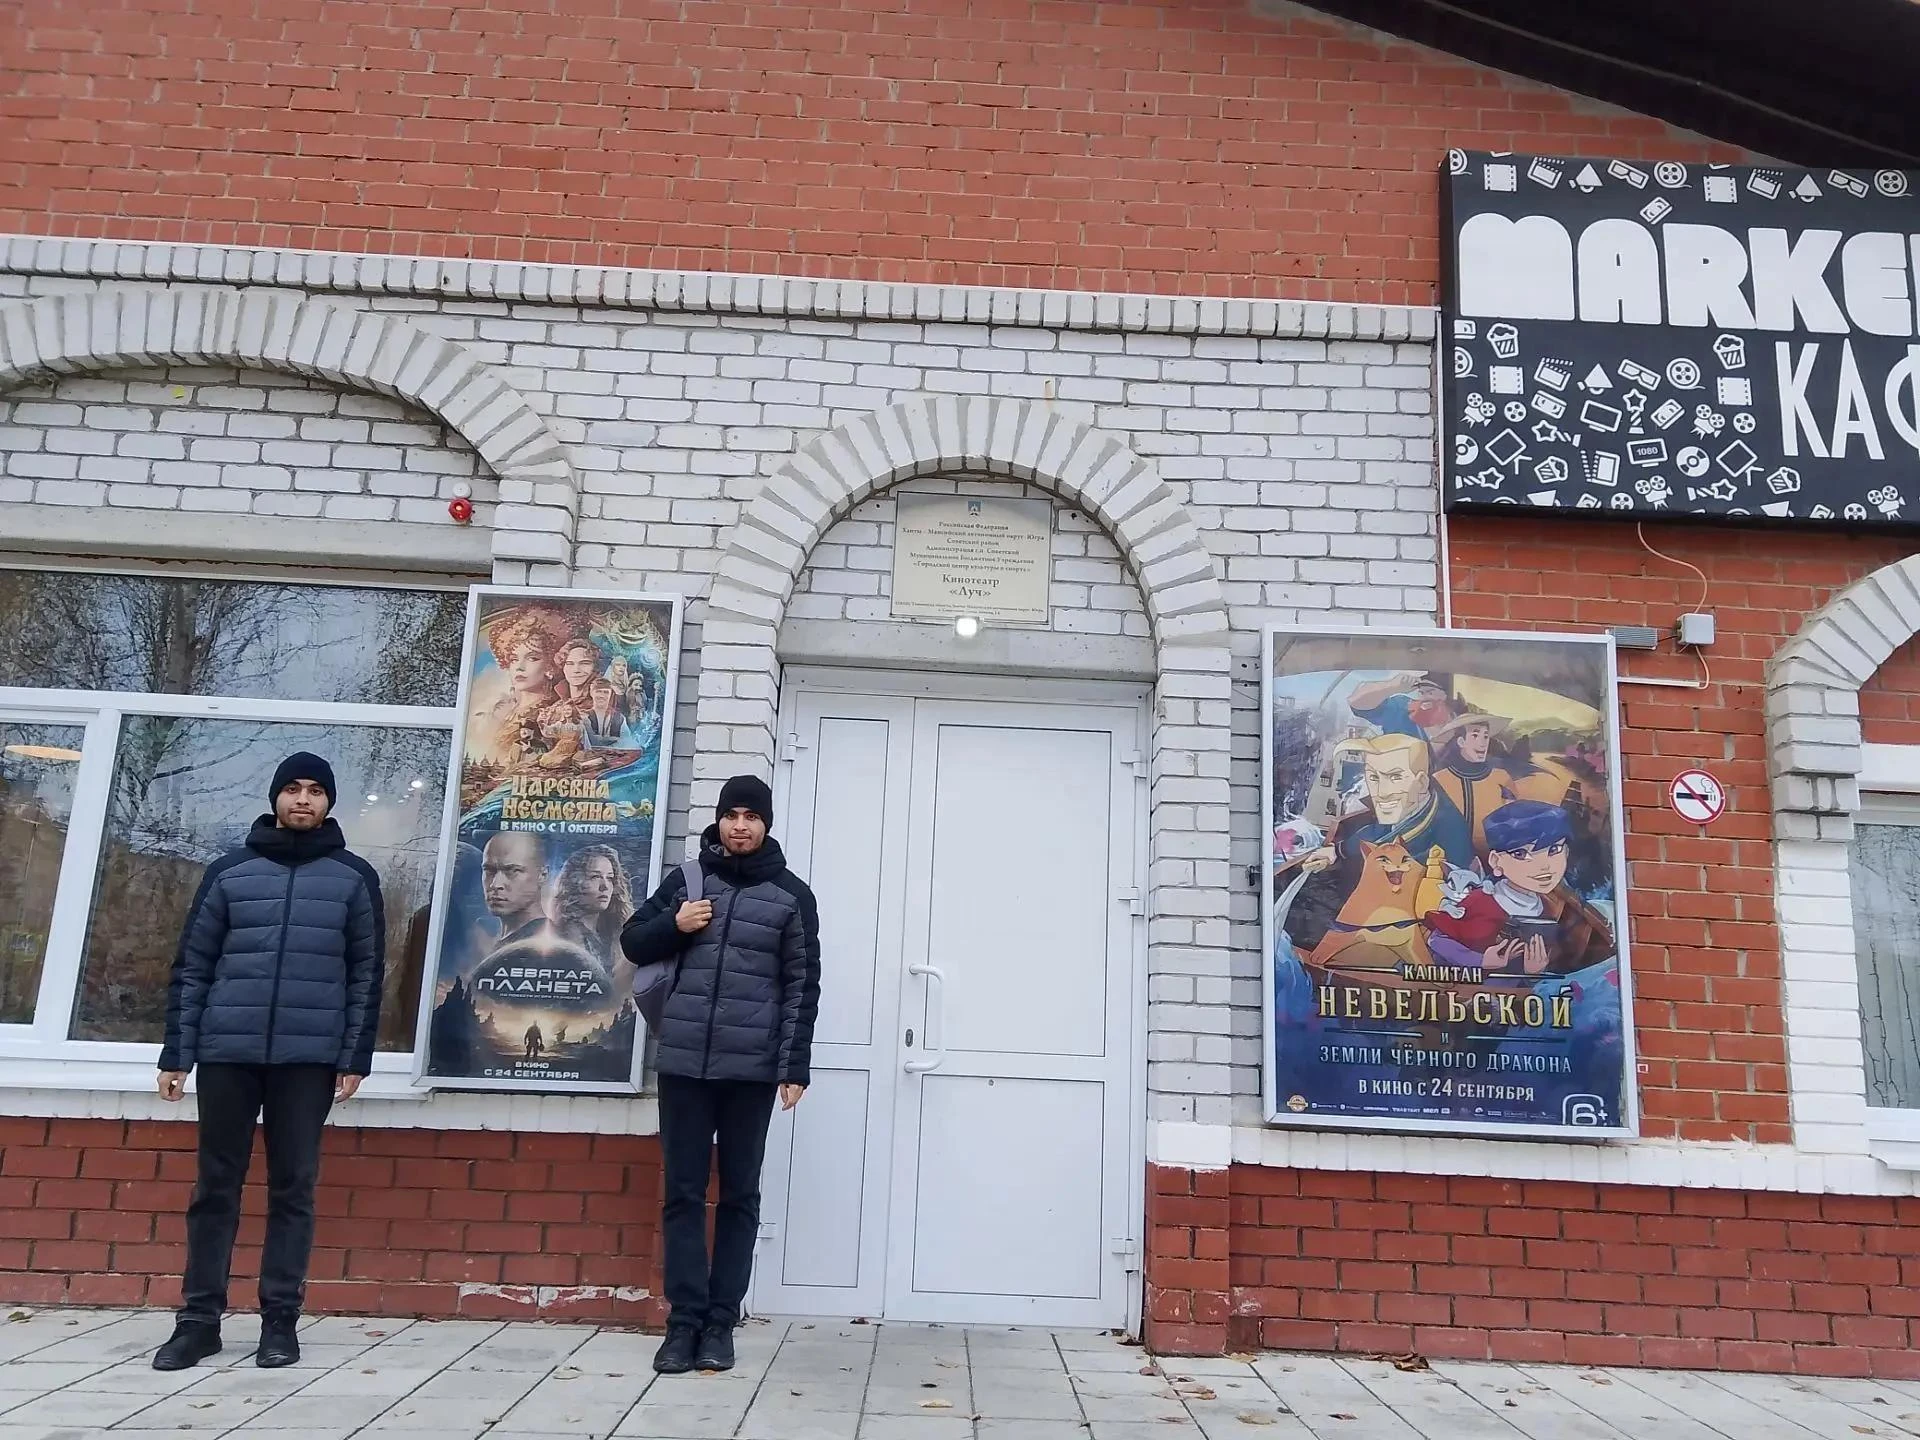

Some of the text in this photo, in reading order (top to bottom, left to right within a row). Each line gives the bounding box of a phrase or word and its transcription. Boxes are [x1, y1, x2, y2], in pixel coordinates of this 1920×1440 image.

[1459, 212, 1920, 336] MARKE
[1636, 446, 1659, 456] 1080
[942, 574, 1000, 588] Кинотеатр
[949, 586, 992, 600] «Луч»
[511, 774, 610, 799] ЦАРЕВНА
[501, 797, 617, 822] НЕСМЕЯНА
[500, 820, 509, 831] В
[511, 821, 546, 832] КИНО
[559, 821, 566, 833] 1
[567, 823, 618, 834] ОКТЯБРЯ
[493, 966, 593, 980] ДЕВЯТАЯ
[1402, 963, 1483, 983] КАПИТАН
[477, 978, 604, 995] ПЛАНЕТА
[1318, 985, 1573, 1028] НЕВЕЛЬСКОЙ
[1440, 1032, 1449, 1044] И
[523, 1061, 550, 1069] КИНО
[1319, 1044, 1572, 1074] ЗЕМЛИ ЧЁРНОГО ДРАКОНА
[484, 1068, 580, 1079] С 24 СЕНТЯБРЯ
[1358, 1077, 1535, 1102] В КИНО С 24 СЕНТЯБРЯ
